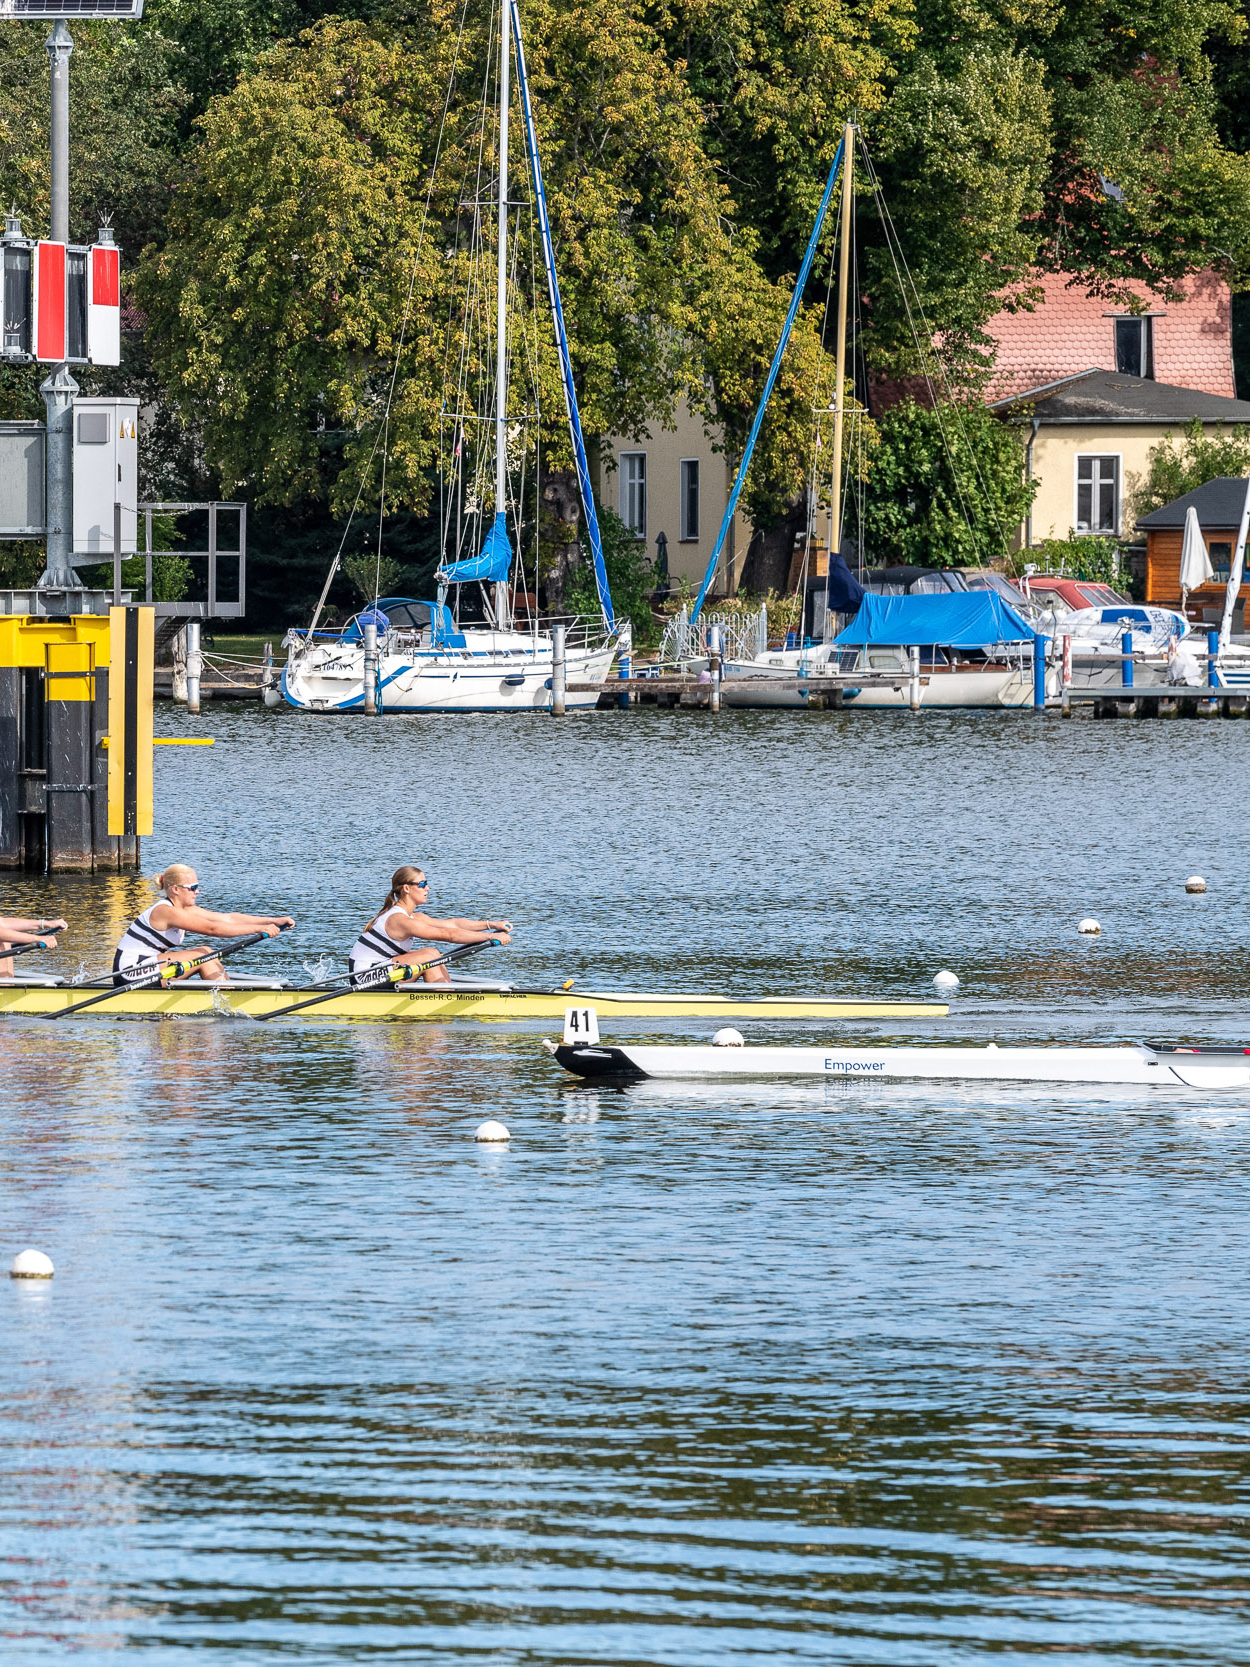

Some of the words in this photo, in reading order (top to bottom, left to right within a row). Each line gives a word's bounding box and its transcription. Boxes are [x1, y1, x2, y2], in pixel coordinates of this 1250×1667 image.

[409, 993, 455, 1001] Bessel-R.C.
[570, 1010, 589, 1032] 41
[824, 1058, 886, 1073] Empower
